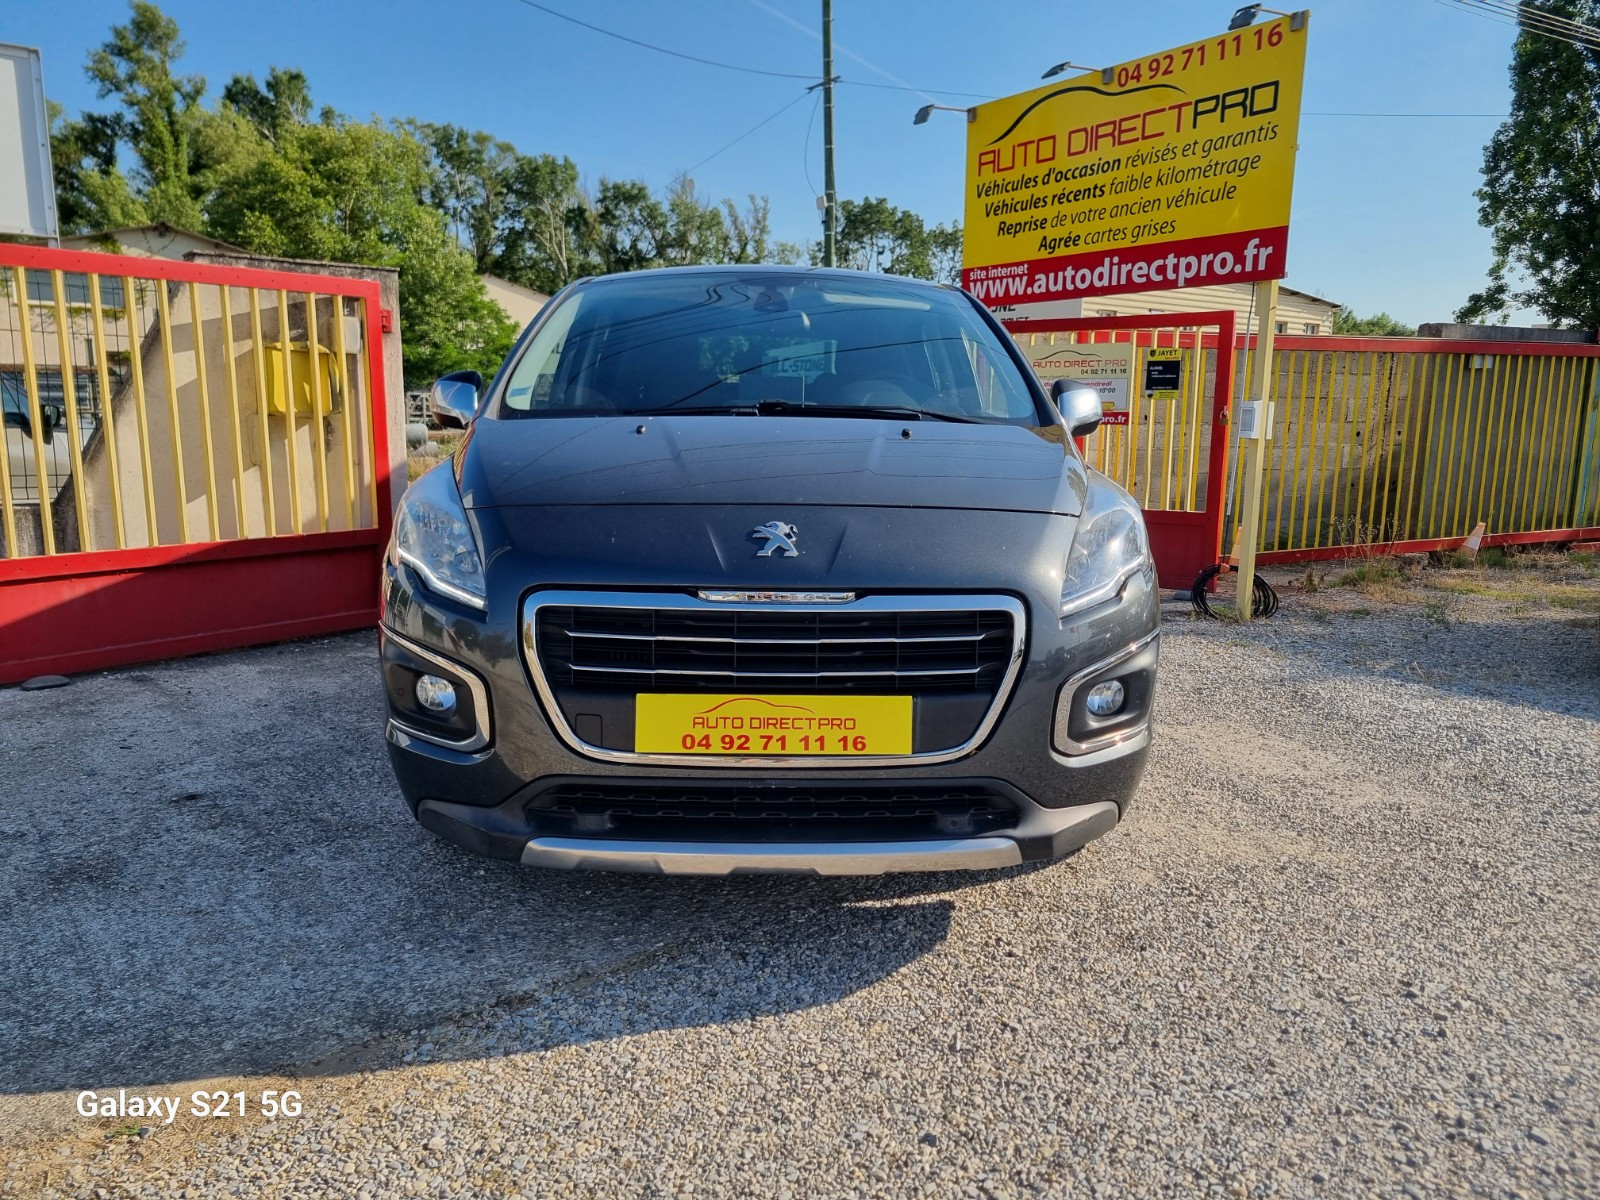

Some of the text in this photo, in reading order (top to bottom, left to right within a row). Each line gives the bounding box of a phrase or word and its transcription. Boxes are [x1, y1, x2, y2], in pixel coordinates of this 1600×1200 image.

[1117, 23, 1283, 88] 04 92 71 11 16
[976, 121, 1279, 198] Véhicules d'occasion révisés et garantis
[978, 135, 1056, 177] AUTO
[985, 154, 1261, 218] Véhicules récents faible kilométrage
[997, 181, 1237, 238] Reprise de votre ancien véhicule
[1038, 219, 1177, 254] Agrée cartes grises
[969, 238, 1273, 299] www.autodirectpro.fr
[969, 263, 1029, 280] site internet
[1033, 359, 1128, 369] AUTO DIRECT PRO
[681, 733, 867, 751] 04 92 71 11 16
[692, 716, 744, 729] AUTO
